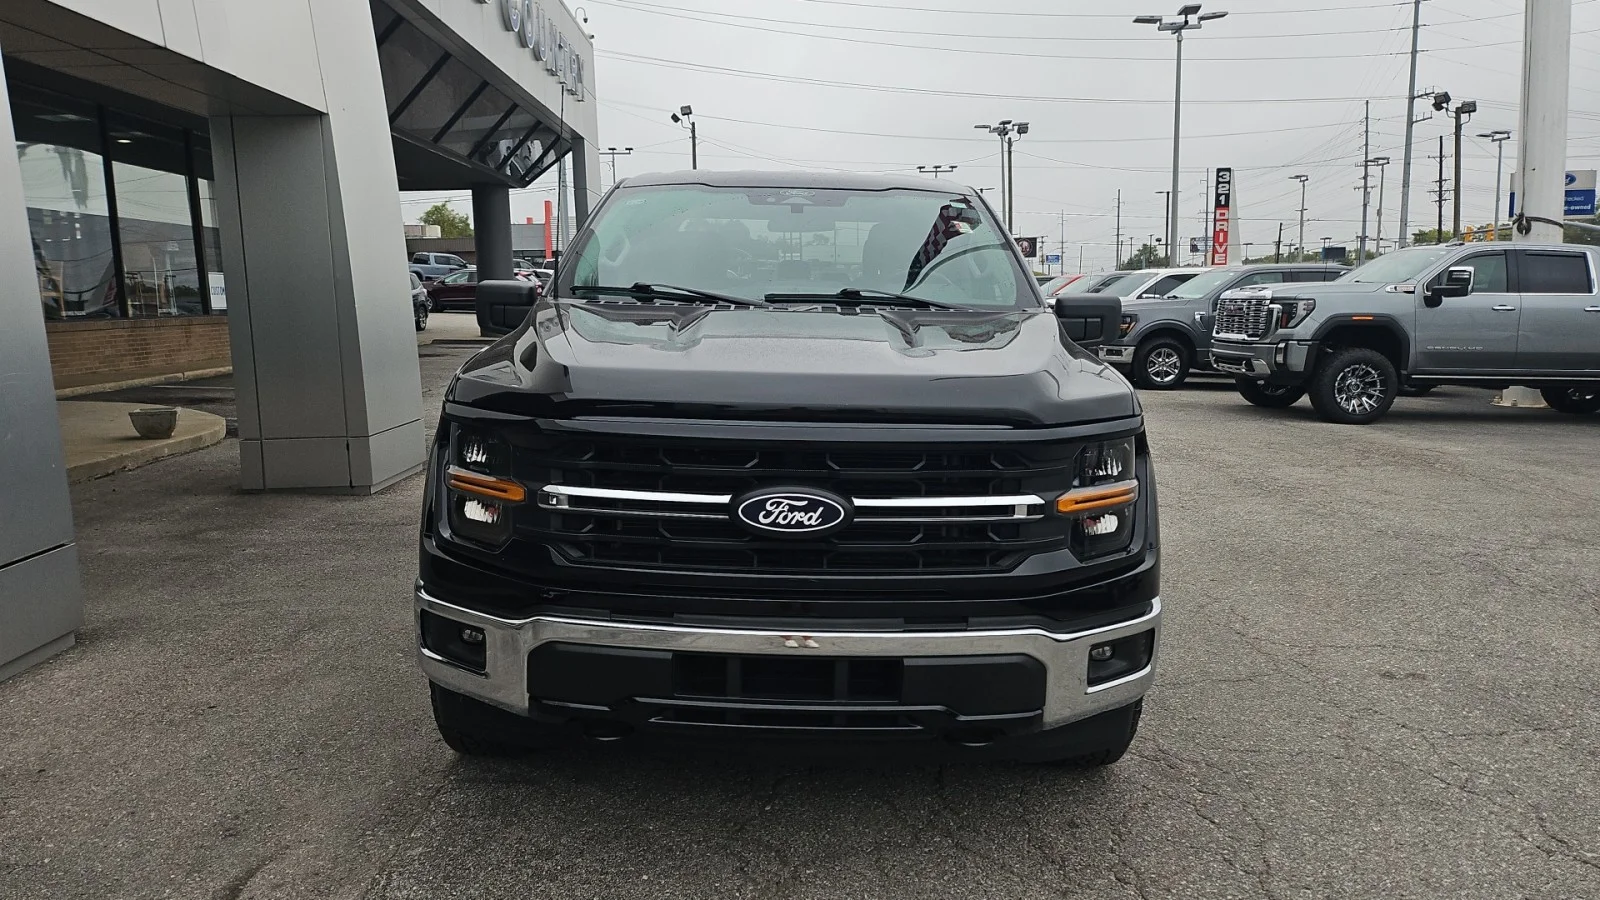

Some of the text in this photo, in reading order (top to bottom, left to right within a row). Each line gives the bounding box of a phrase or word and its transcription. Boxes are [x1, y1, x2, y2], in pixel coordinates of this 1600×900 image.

[1215, 171, 1230, 264] 321 DRIVE
[758, 498, 824, 526] Ford
